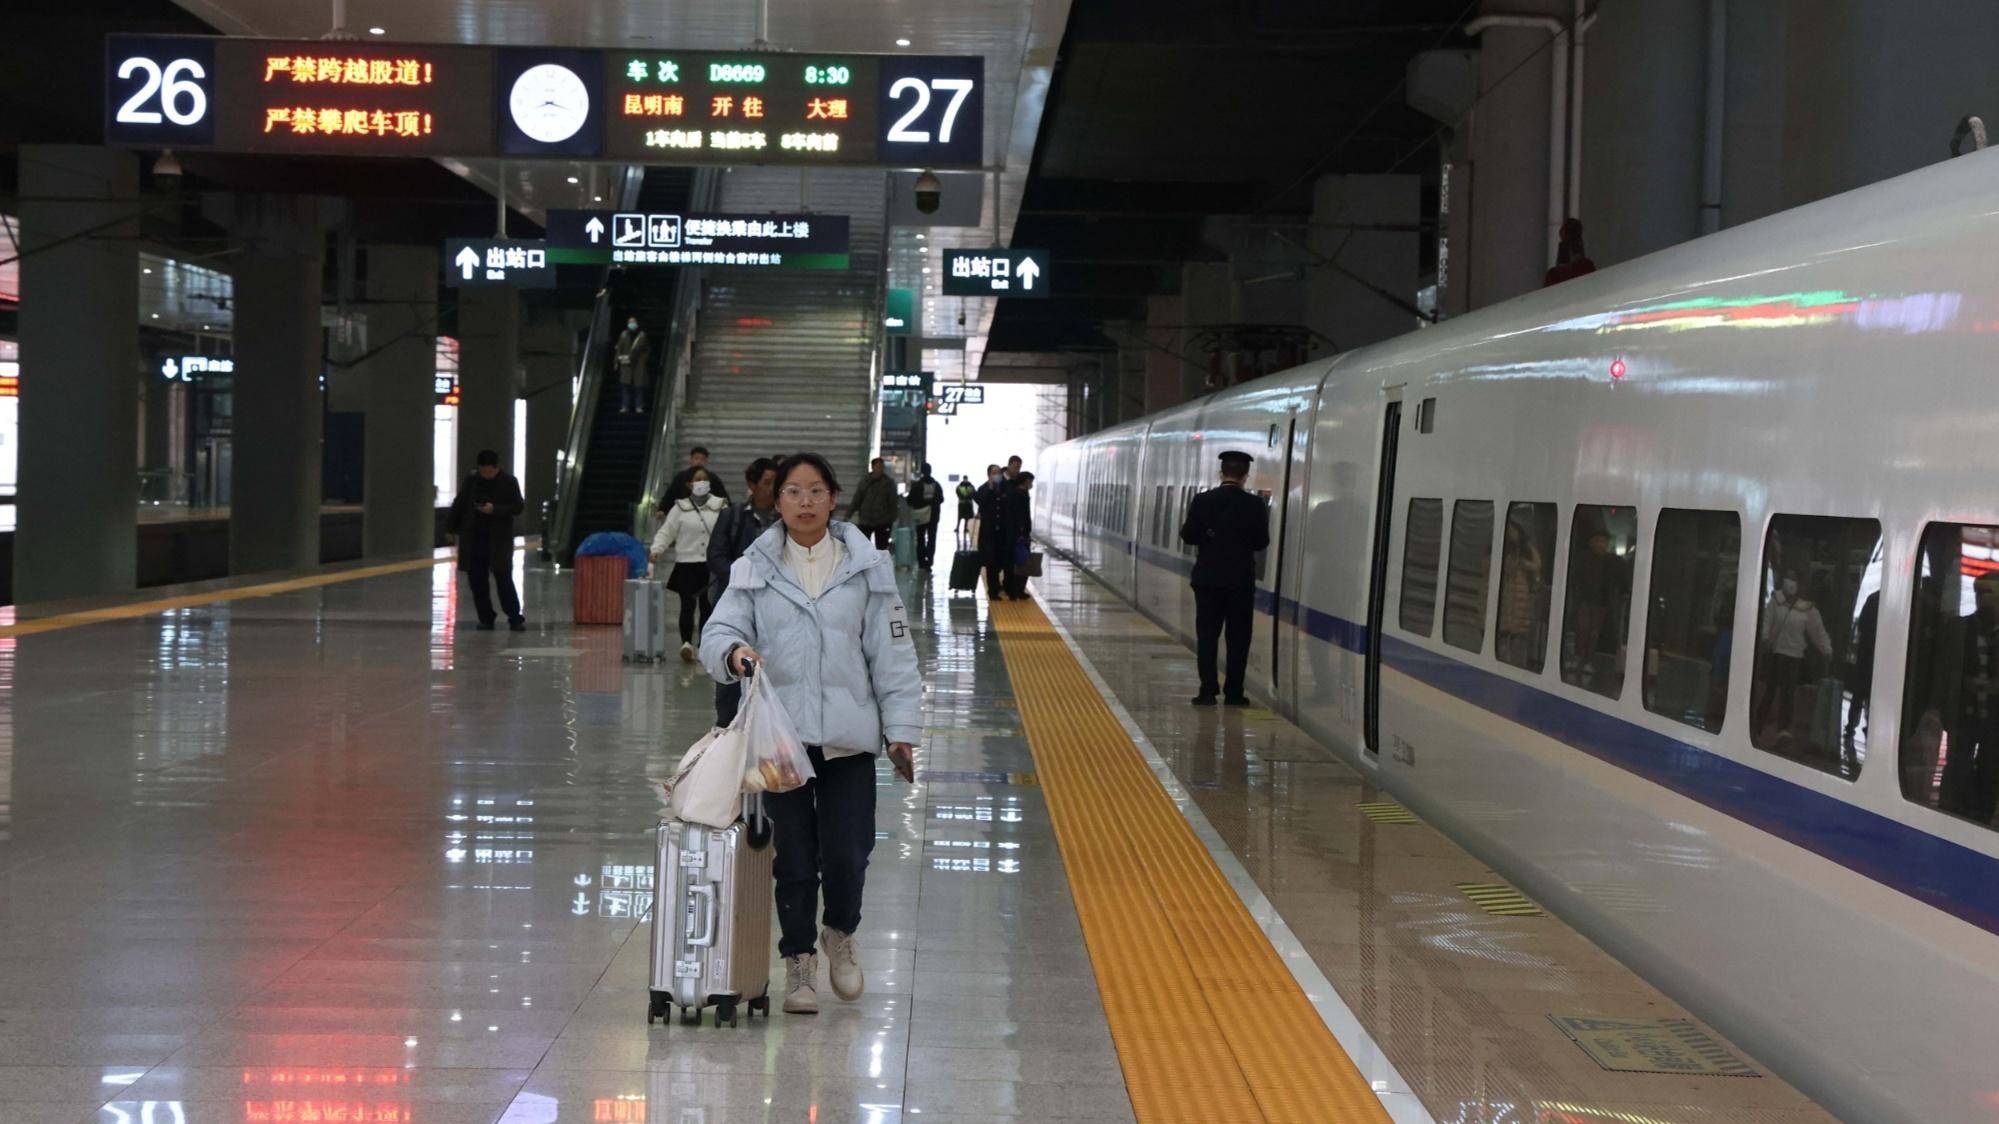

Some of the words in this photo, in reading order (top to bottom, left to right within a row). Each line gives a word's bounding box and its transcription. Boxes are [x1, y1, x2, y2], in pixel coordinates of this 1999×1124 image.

[709, 63, 765, 83] D8669
[804, 66, 850, 85] 8:30
[116, 57, 207, 125] 26
[624, 94, 684, 115] 昆明南
[807, 98, 848, 120] 大理
[887, 78, 974, 142] 27
[486, 246, 546, 269] 出站口
[952, 256, 1010, 278] 出站口
[945, 387, 964, 402] 27
